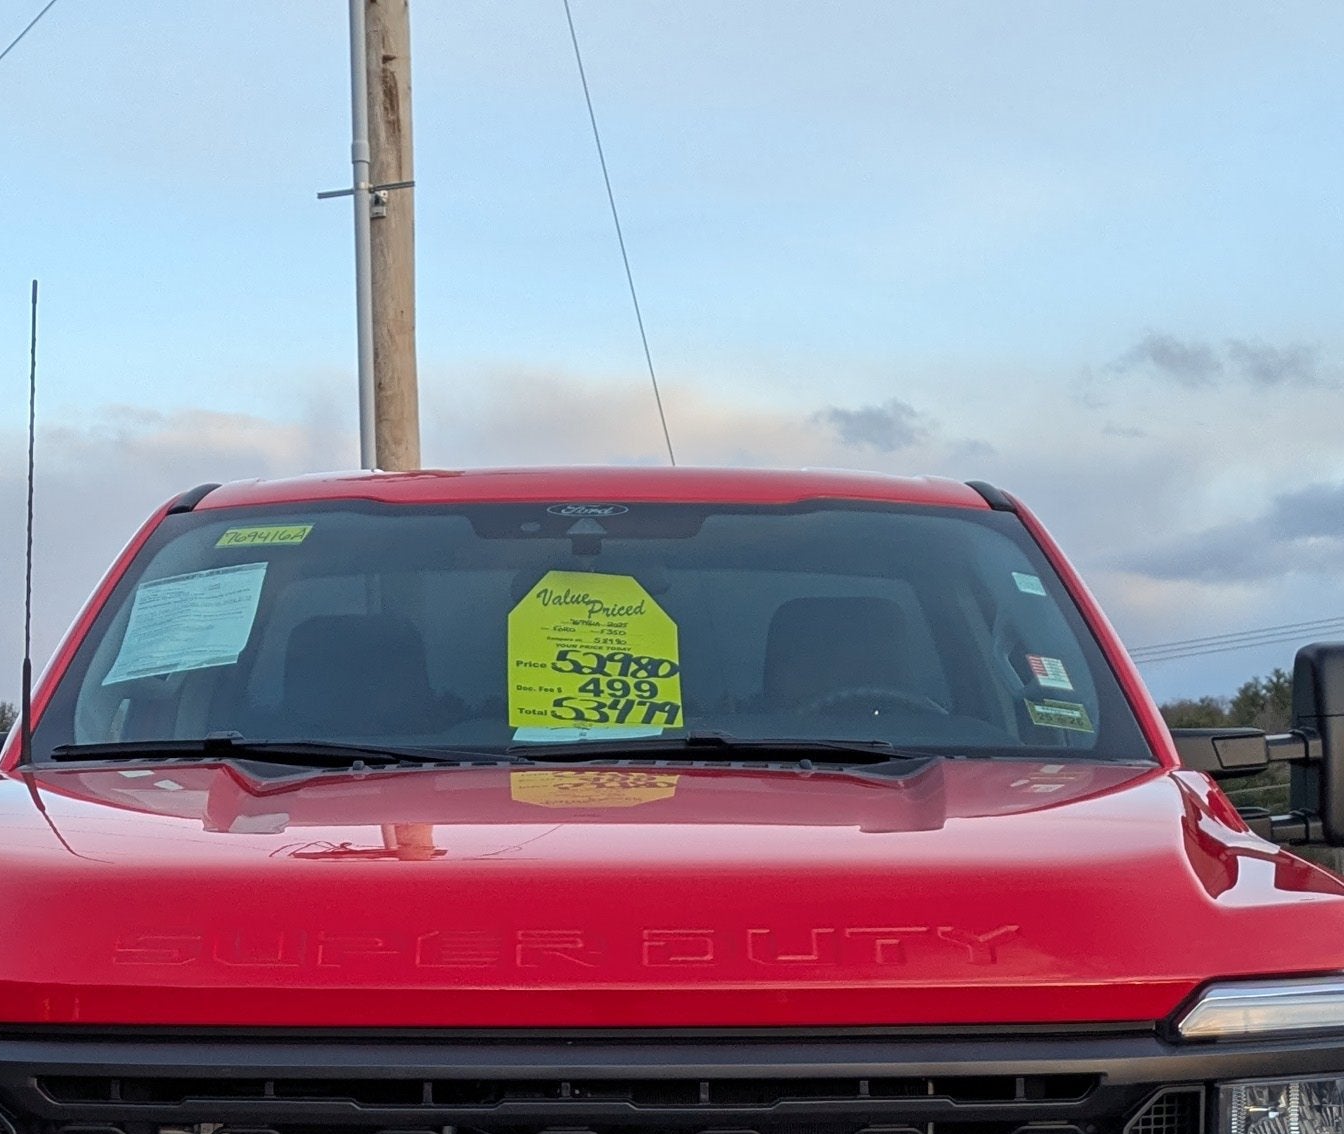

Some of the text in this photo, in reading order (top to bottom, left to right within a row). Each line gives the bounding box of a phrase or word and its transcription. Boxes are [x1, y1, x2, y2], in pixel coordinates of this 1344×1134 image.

[536, 588, 592, 607] Value
[587, 599, 646, 619] Priced
[515, 660, 547, 669] Price
[516, 684, 536, 693] Doc.
[538, 685, 555, 694] Fee
[578, 677, 659, 700] 499
[517, 707, 548, 717] Total
[111, 925, 1020, 968] SUPER DUTY
